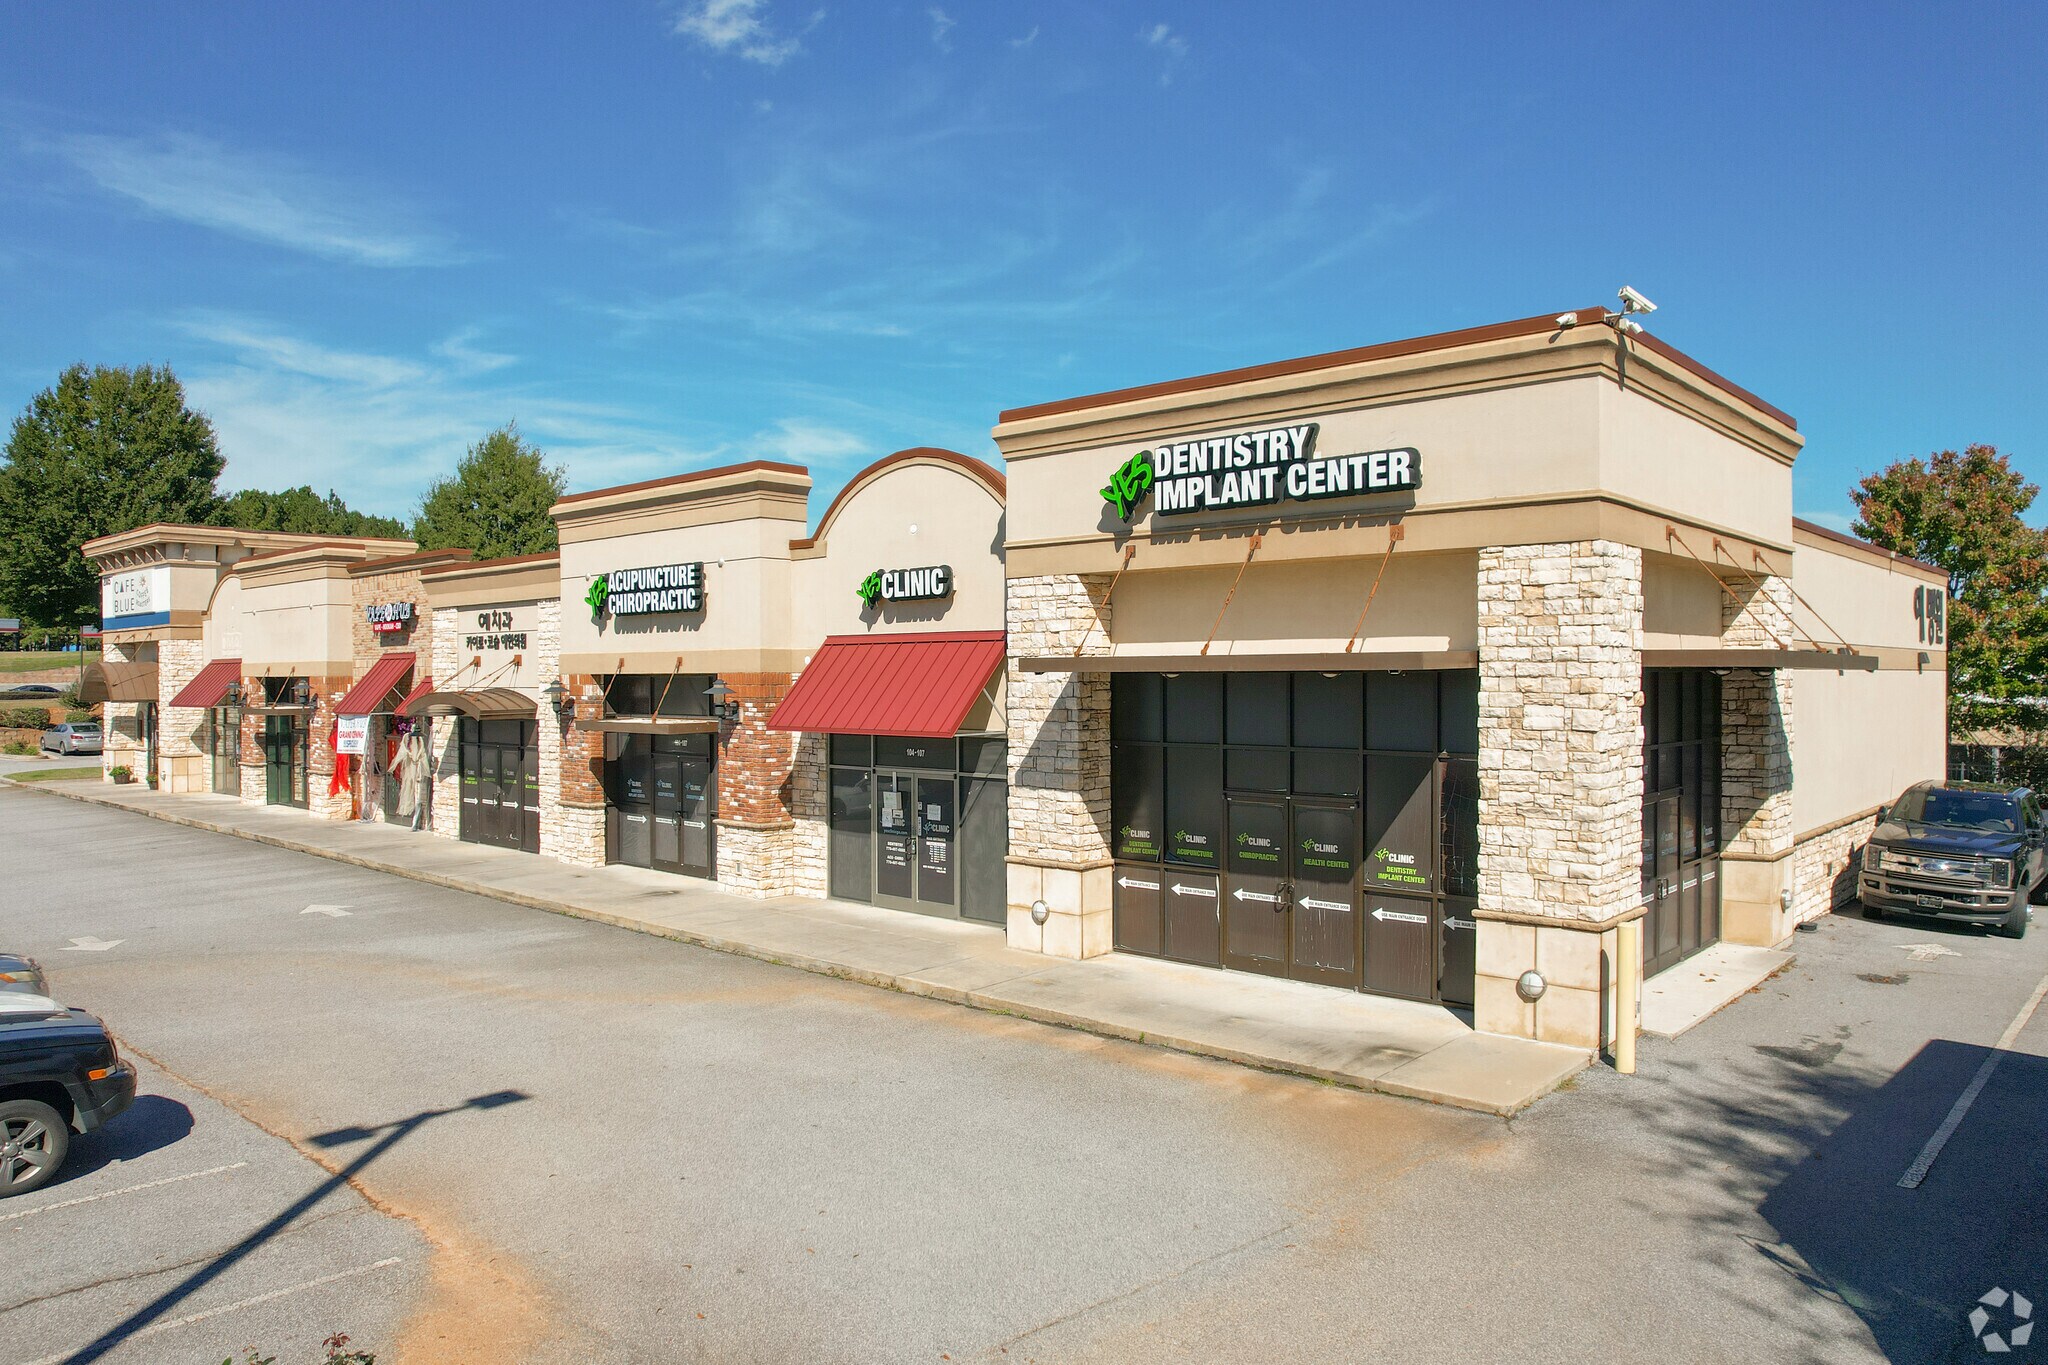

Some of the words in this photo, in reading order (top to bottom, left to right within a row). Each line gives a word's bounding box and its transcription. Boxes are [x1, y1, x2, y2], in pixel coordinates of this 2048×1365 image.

[1154, 425, 1310, 478] DENTISTRY
[1099, 452, 1153, 518] YES
[1154, 466, 1278, 511] IMPLANT
[1287, 450, 1411, 496] CENTER
[607, 564, 696, 593] ACUPUNCTURE
[856, 571, 881, 607] YES
[881, 568, 944, 599] CLINIC
[584, 575, 608, 617] YES
[608, 587, 696, 614] CHIROPRACTIC
[114, 597, 135, 613] BLUE
[478, 609, 514, 631] 예치과
[906, 748, 925, 757] 104-107
[1130, 829, 1151, 839] CLINIC
[1185, 834, 1207, 844] CLINIC
[1248, 837, 1271, 847] CLINIC
[1176, 848, 1214, 858] ACUPUNCTURE
[1314, 843, 1339, 854] CLINIC
[1239, 851, 1278, 861] CHIROPRACTIC
[1388, 853, 1415, 864] CLINIC
[1303, 858, 1326, 867] HEALTH
[1326, 860, 1350, 869] CENTER
[1386, 865, 1417, 875] DENTISTRY
[1377, 872, 1402, 881] IMPLANT
[1403, 874, 1426, 884] CENTER
